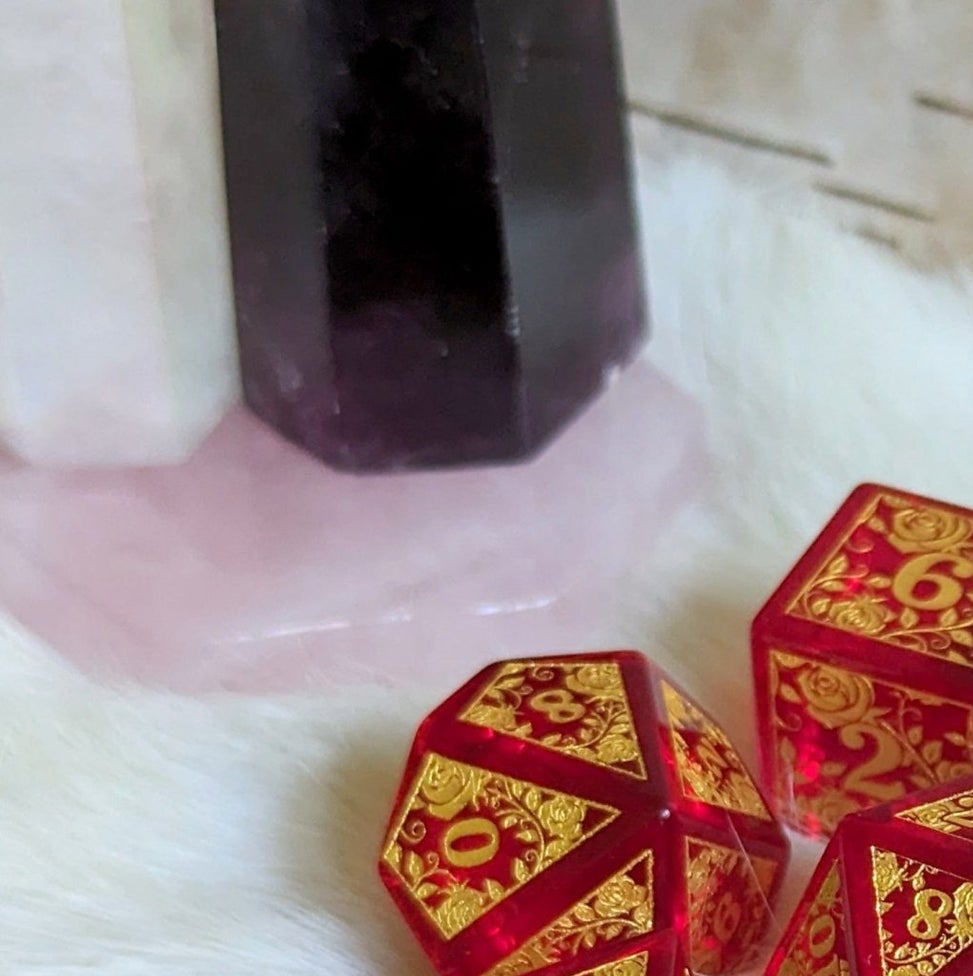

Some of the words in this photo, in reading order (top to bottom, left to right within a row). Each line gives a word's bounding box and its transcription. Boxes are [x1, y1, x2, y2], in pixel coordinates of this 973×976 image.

[530, 688, 586, 723] 8
[840, 721, 907, 801] 2
[444, 817, 499, 868] 0
[906, 888, 954, 940] 8
